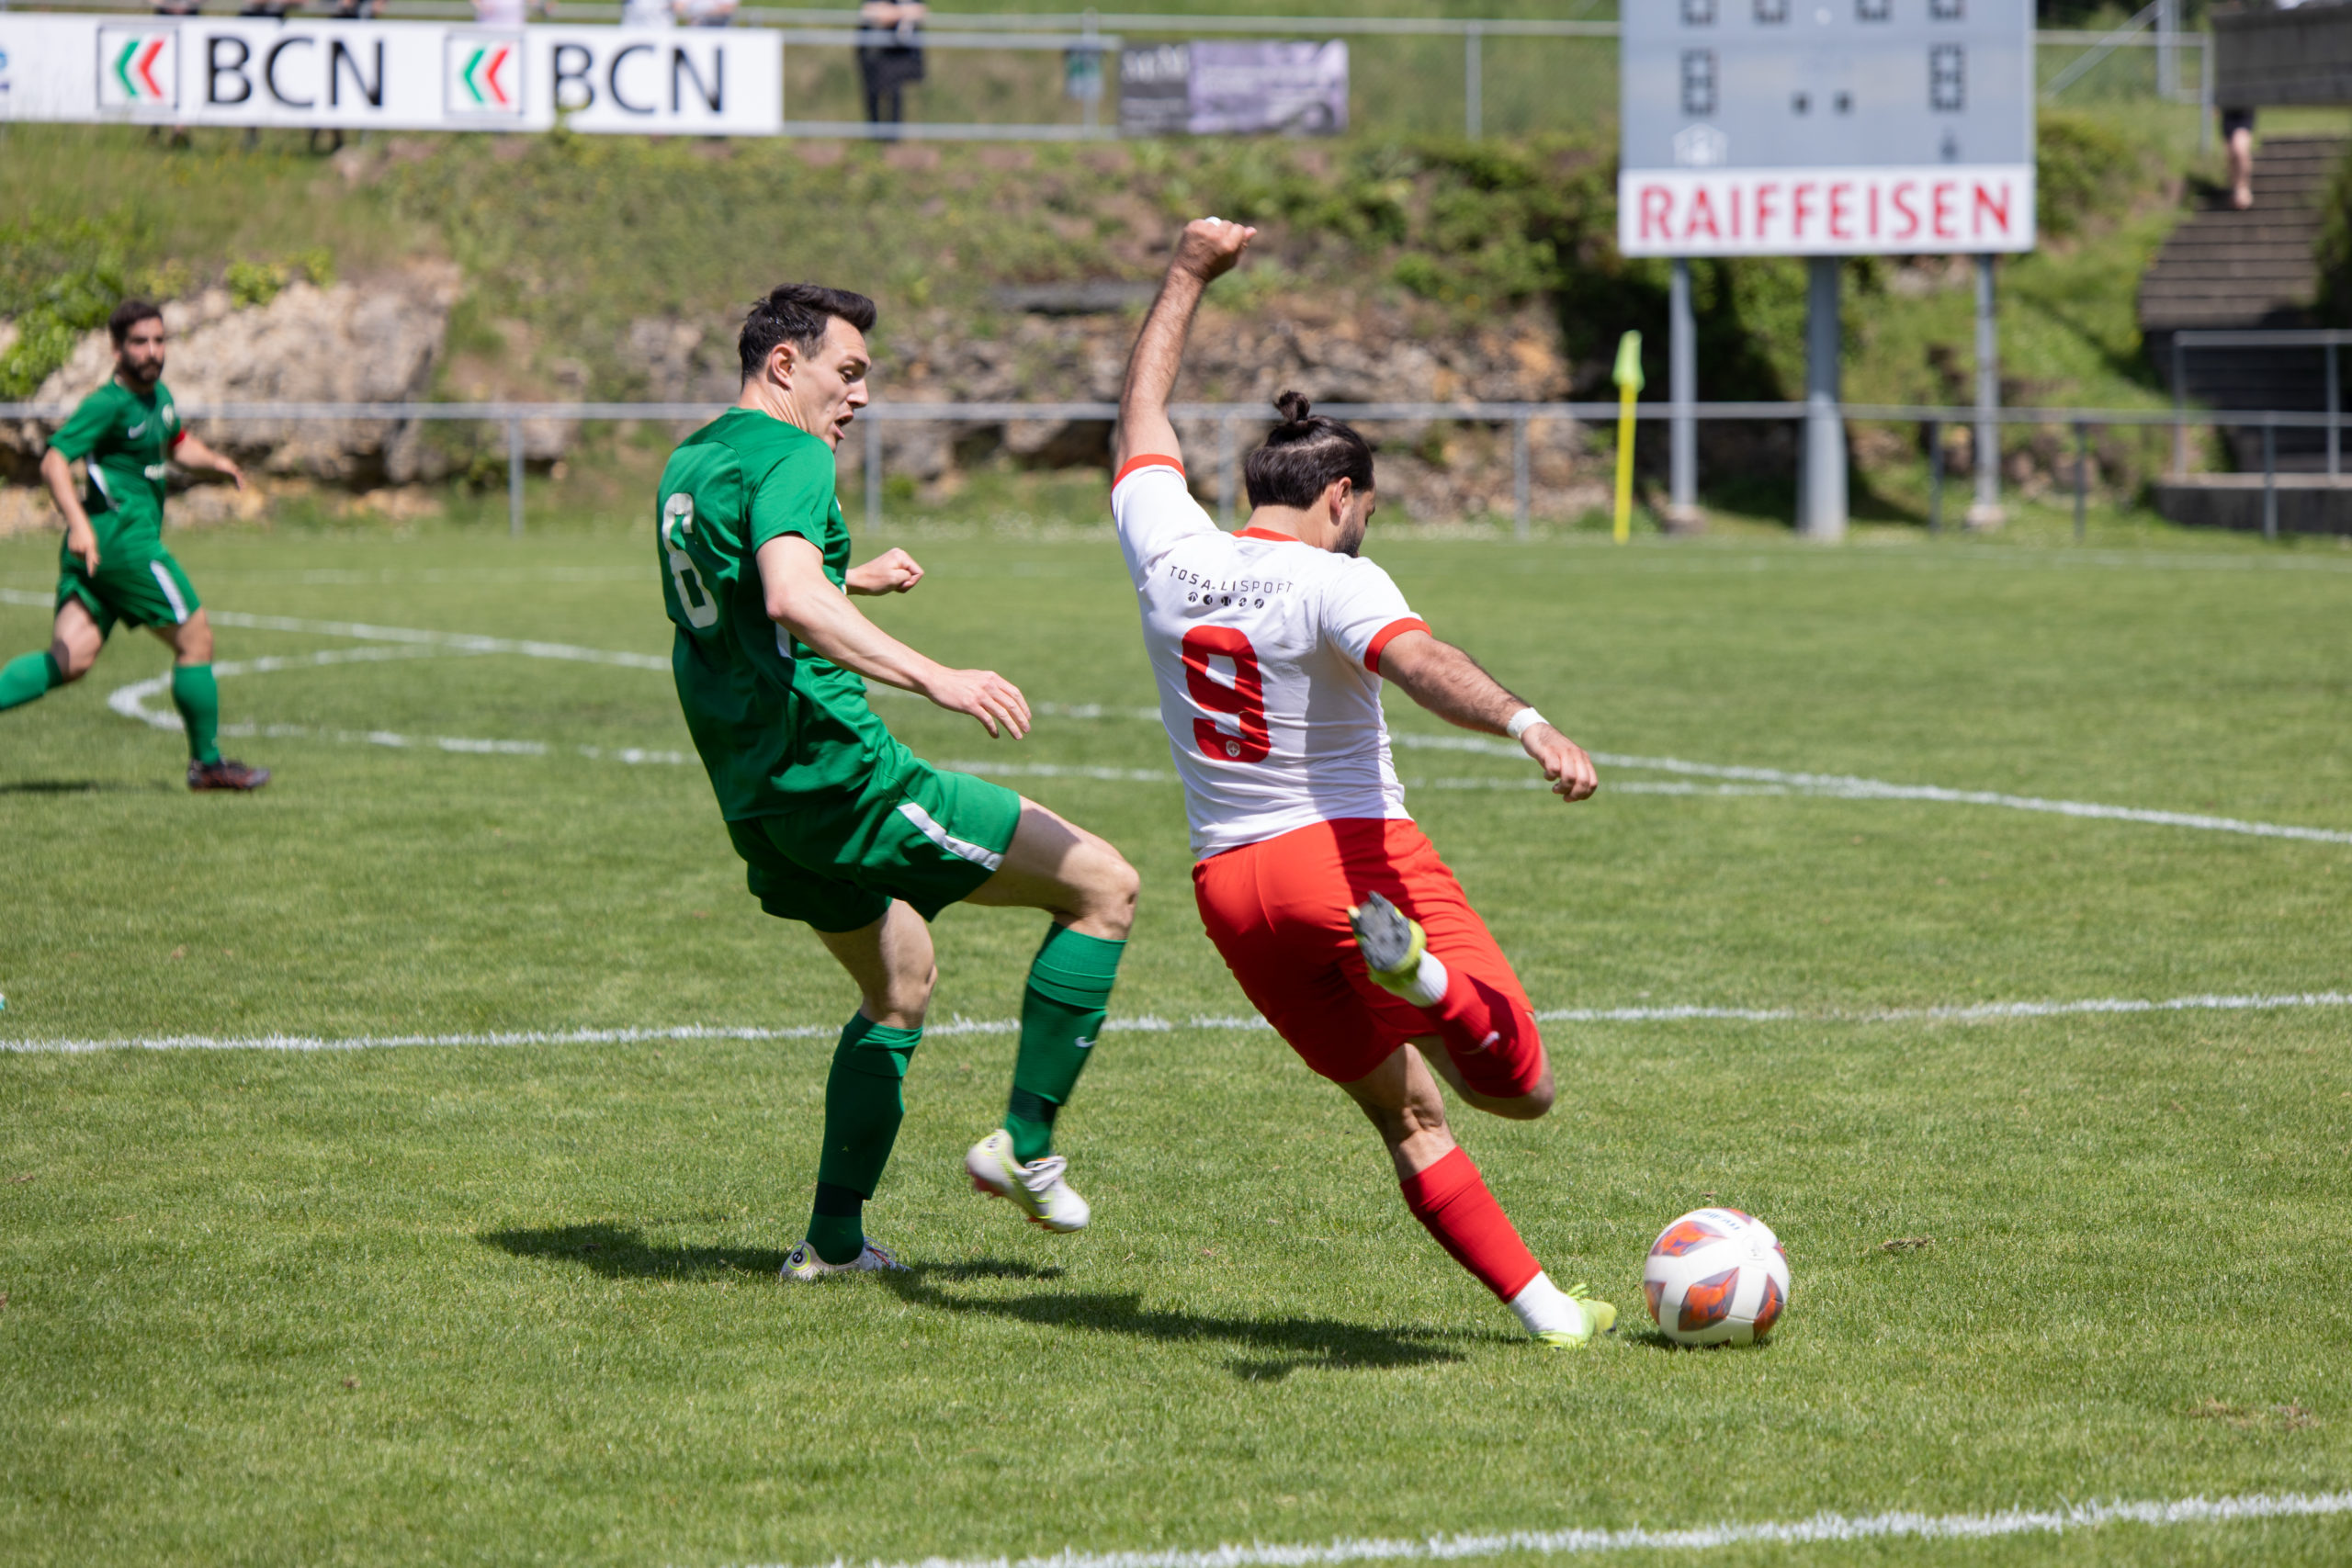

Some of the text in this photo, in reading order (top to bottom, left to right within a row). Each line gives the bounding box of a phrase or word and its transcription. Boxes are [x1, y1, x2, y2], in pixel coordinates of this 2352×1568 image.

[206, 36, 385, 108] BCN
[551, 42, 725, 114] BCN
[1638, 180, 2012, 241] RAIFFEISEN
[662, 492, 718, 629] 6
[1170, 565, 1294, 594] TOSALISPOT
[1182, 625, 1271, 763] 9
